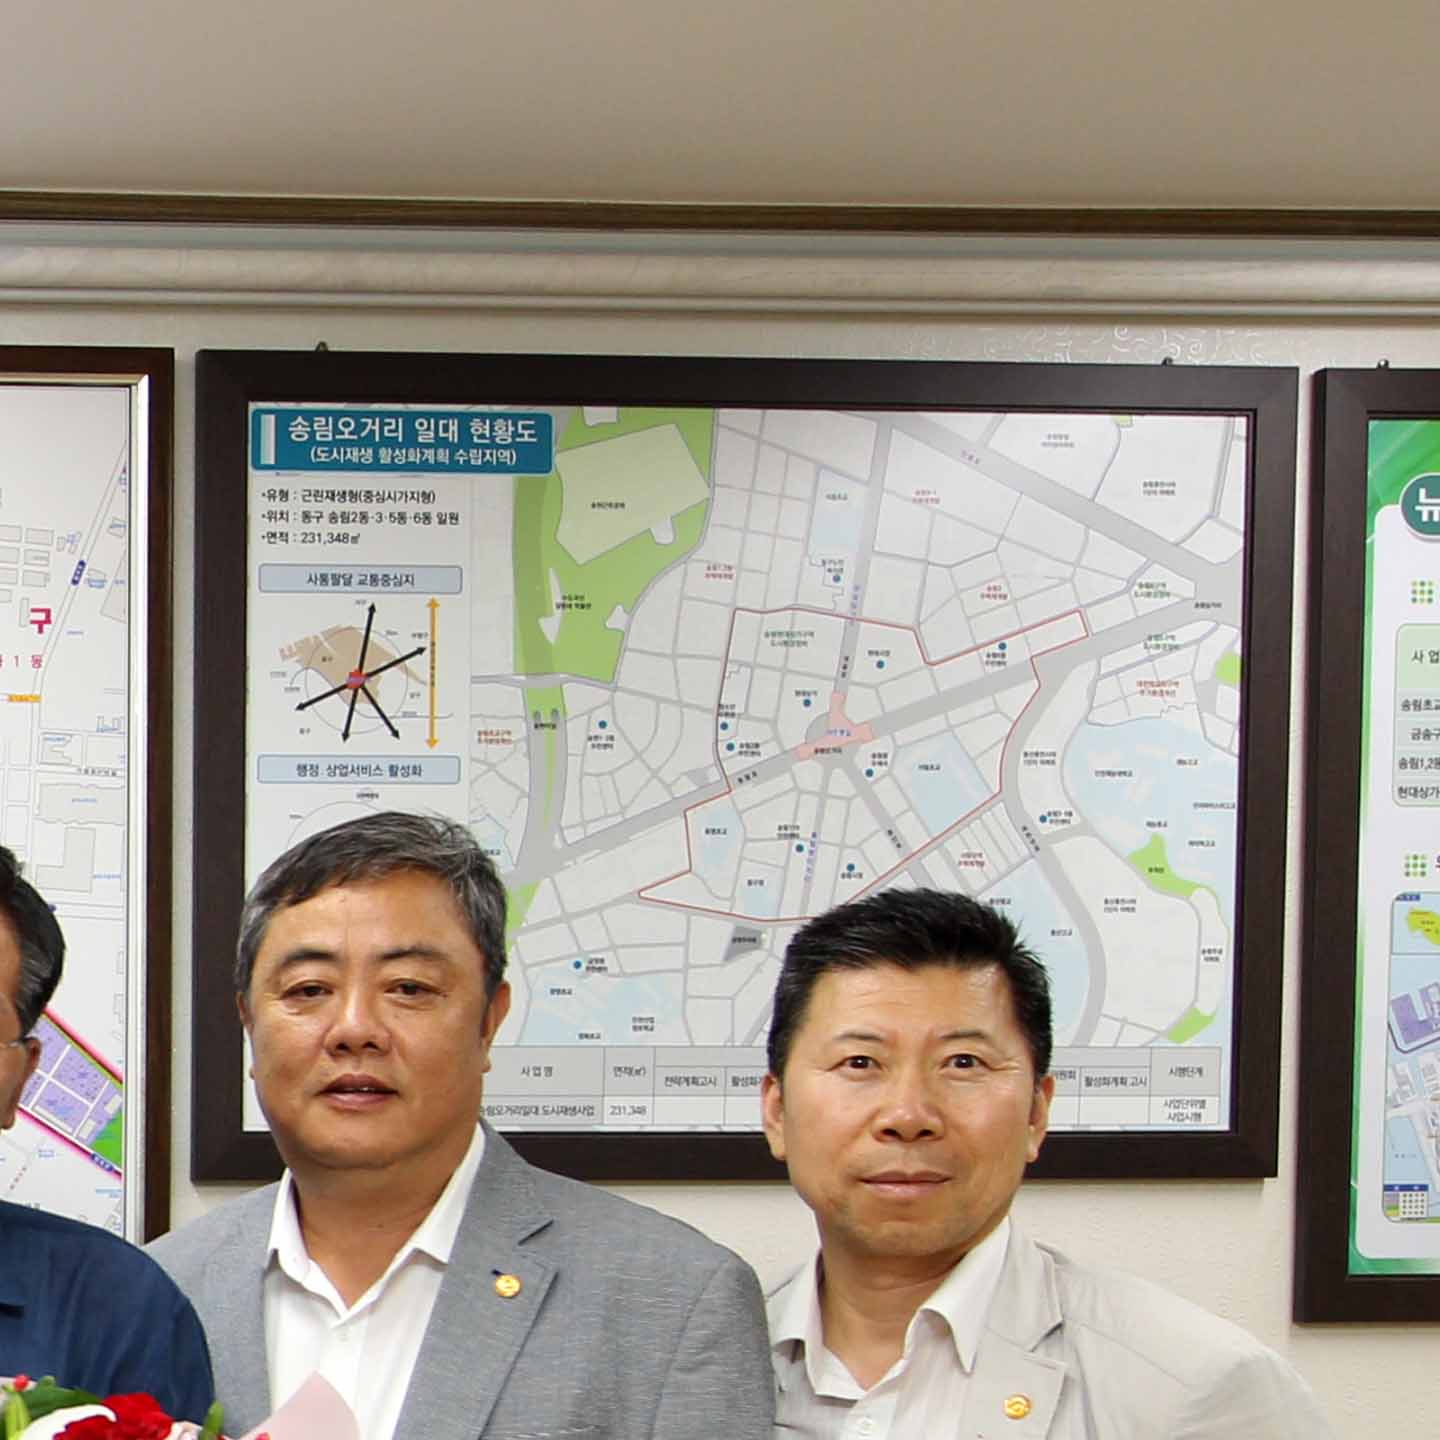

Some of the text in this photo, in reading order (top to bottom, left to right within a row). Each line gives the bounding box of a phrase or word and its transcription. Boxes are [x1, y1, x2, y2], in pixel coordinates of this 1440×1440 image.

[288, 416, 537, 444] 송림오거리 일대 현황도
[310, 447, 517, 465] (도시재생 활성화계획 수립지역)
[301, 511, 323, 523] 동구
[307, 573, 415, 587] 사통팔달 교통중심지
